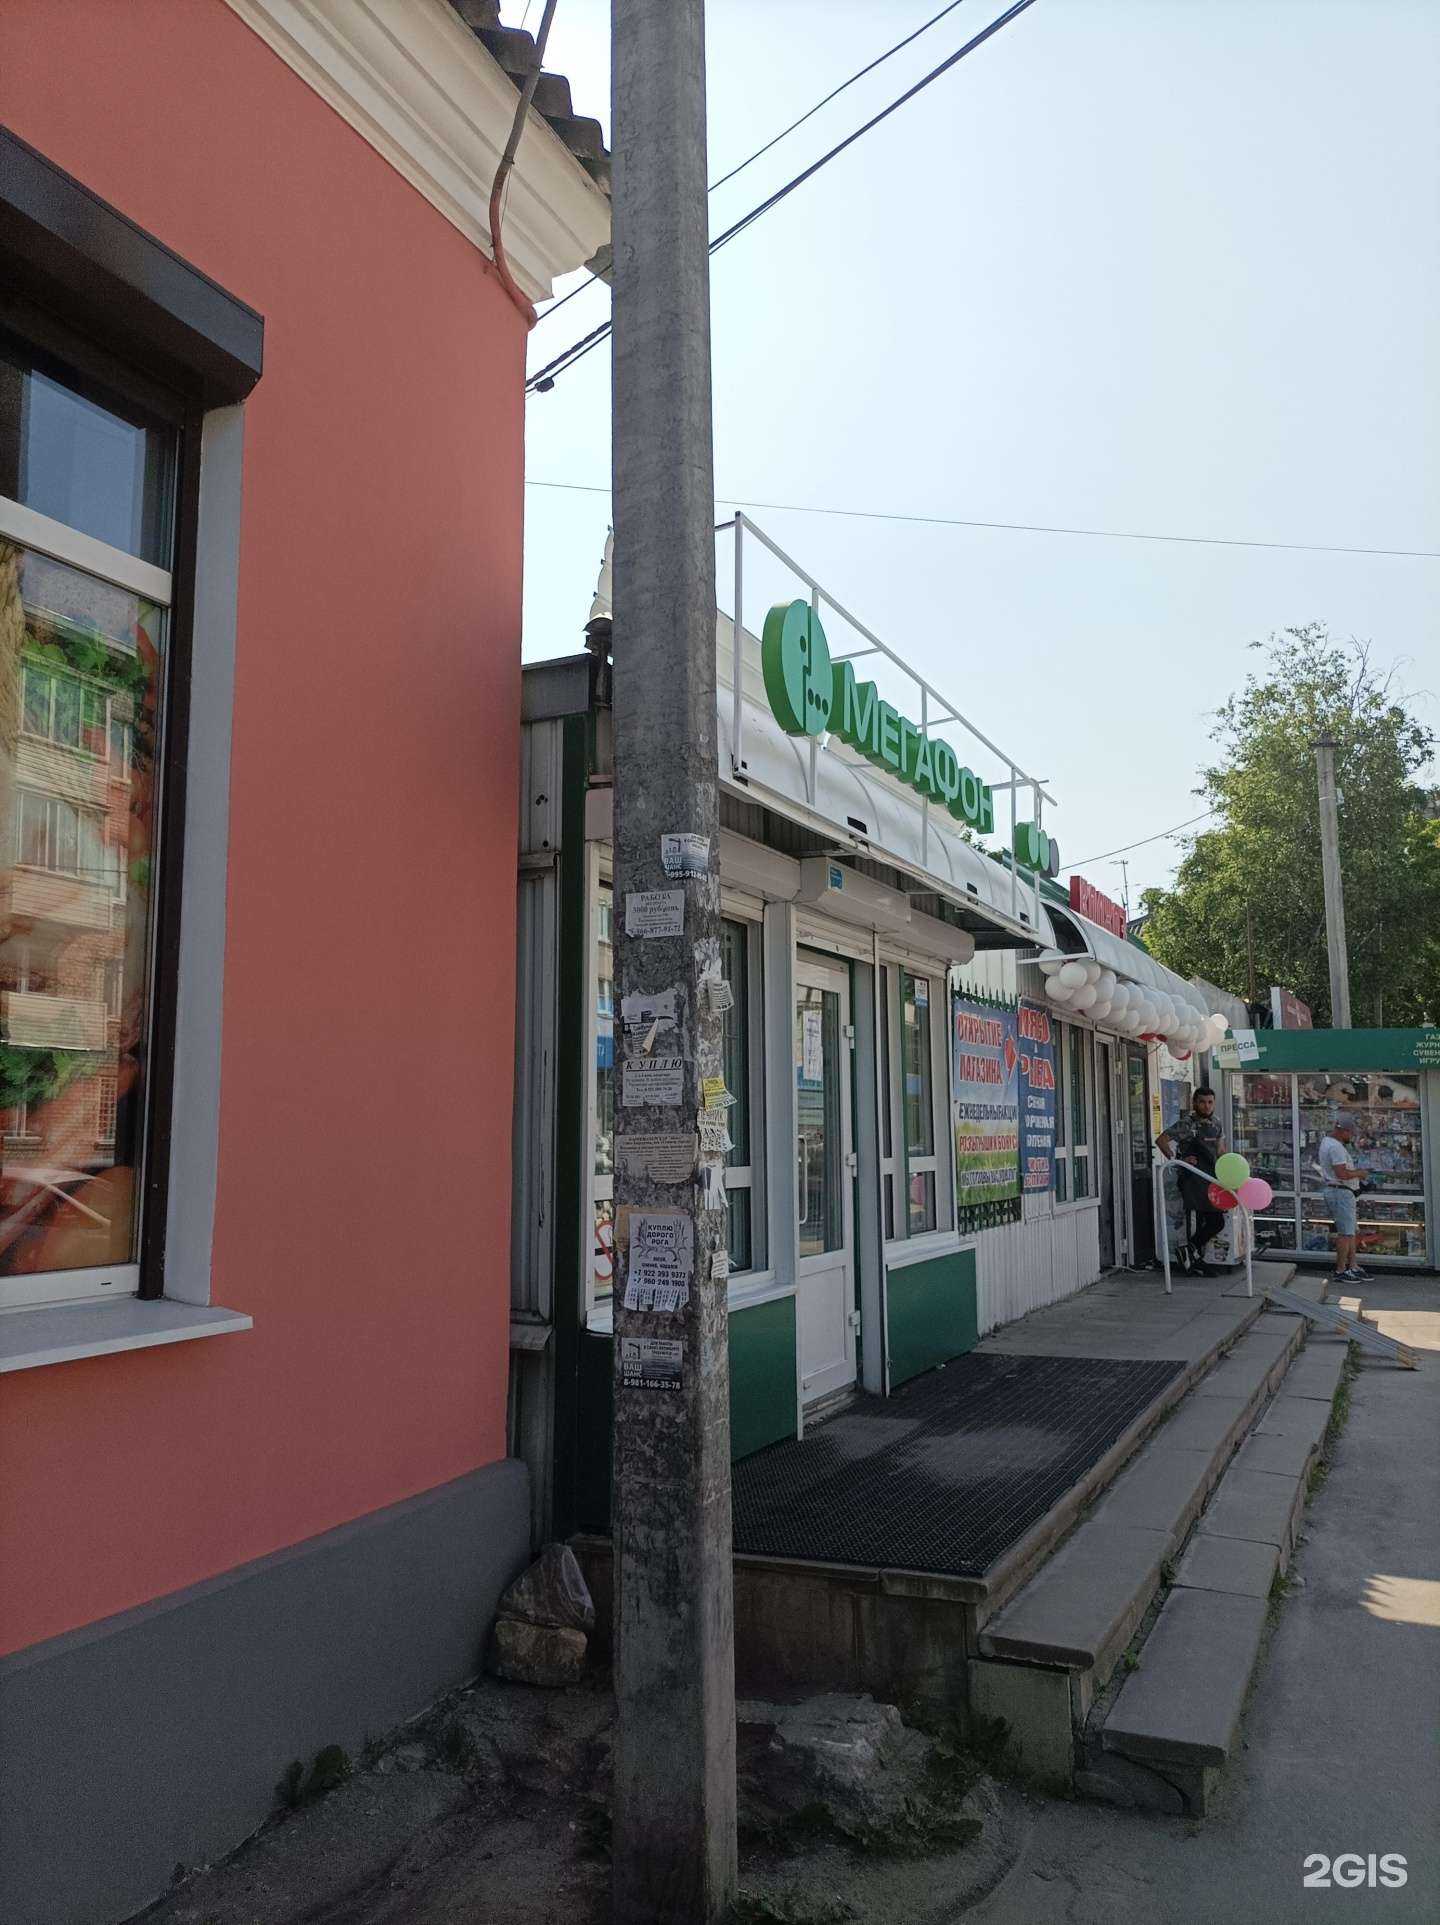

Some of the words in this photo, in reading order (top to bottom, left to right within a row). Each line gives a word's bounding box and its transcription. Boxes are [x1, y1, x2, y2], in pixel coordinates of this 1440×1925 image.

[958, 1012, 1002, 1048] ОТКРЫТИЕ
[1220, 1041, 1256, 1052] ПРЕССА
[647, 1231, 674, 1239] ДОРОГО
